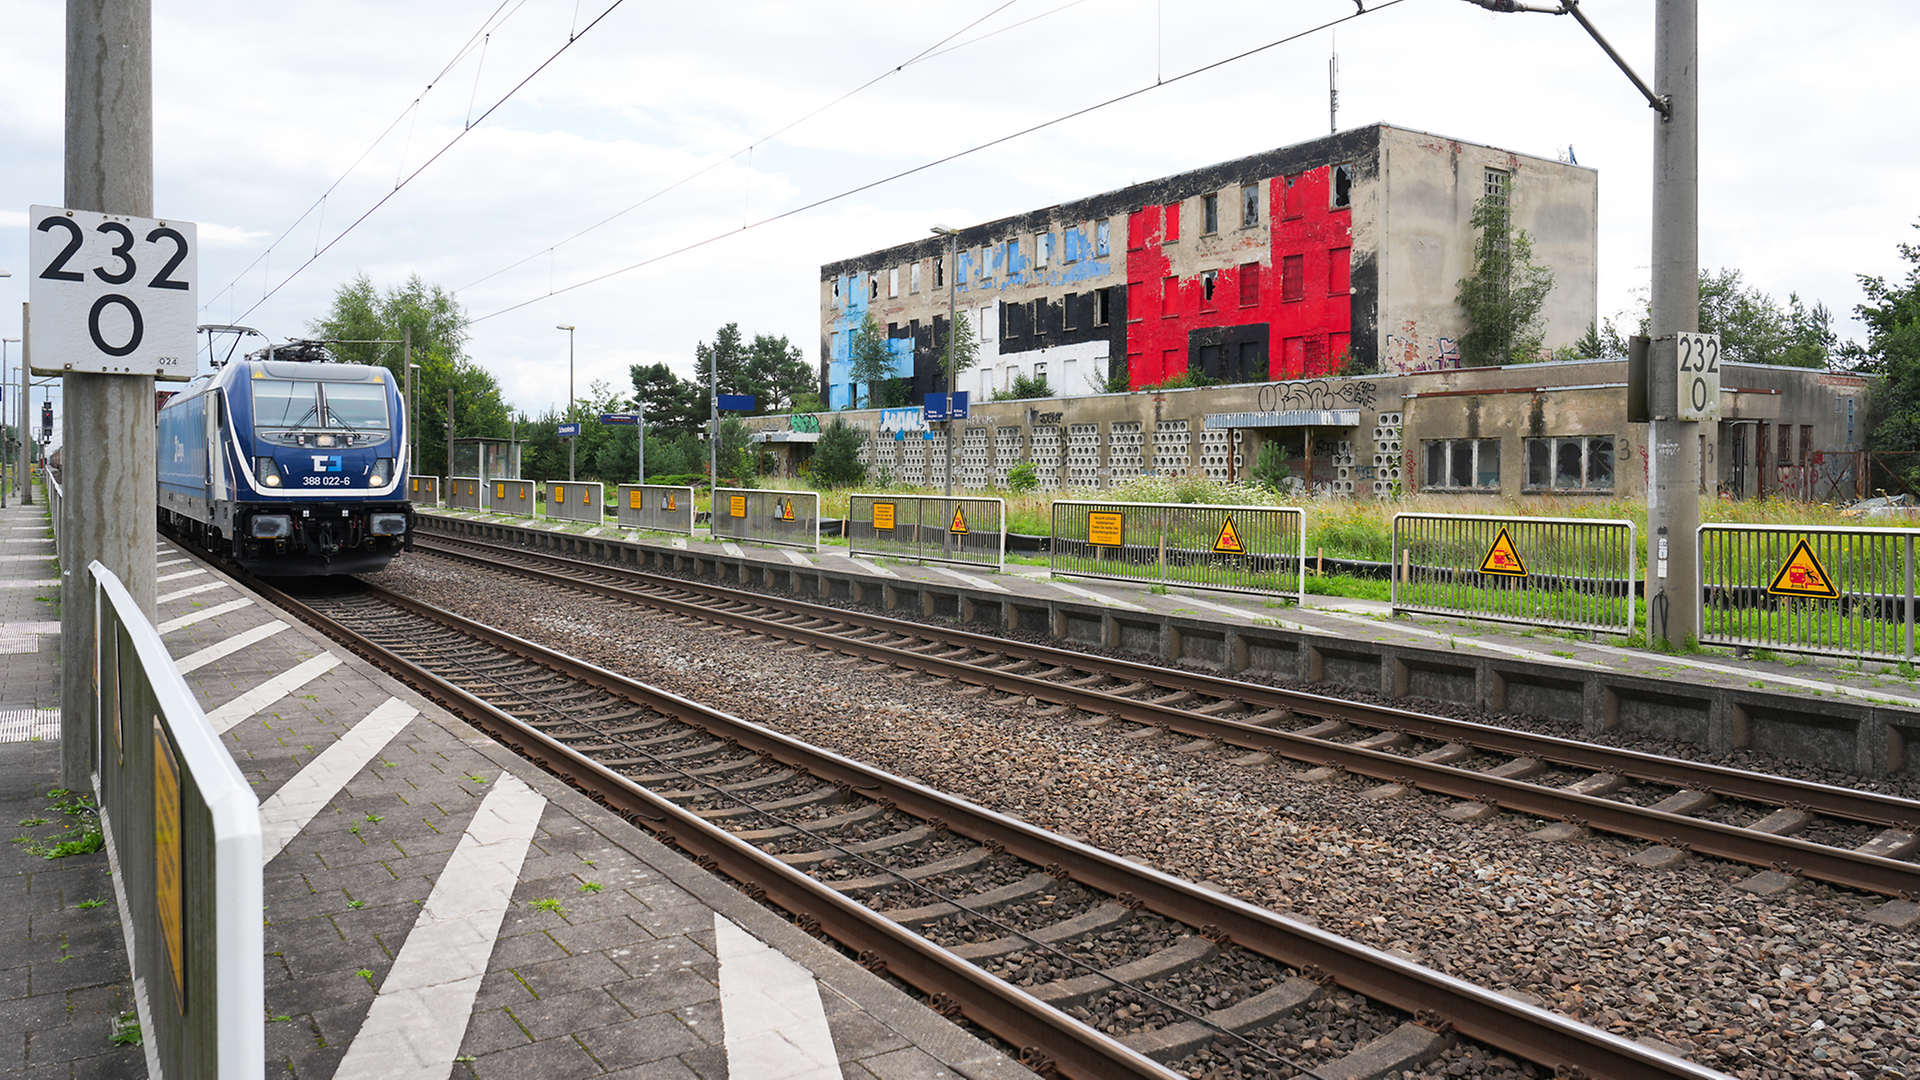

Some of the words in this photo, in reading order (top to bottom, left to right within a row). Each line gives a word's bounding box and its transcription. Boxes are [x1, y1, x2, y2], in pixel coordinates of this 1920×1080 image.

[36, 215, 190, 291] 232
[88, 293, 144, 357] 0
[158, 357, 177, 365] 024
[1679, 336, 1719, 374] 232
[1692, 376, 1707, 412] 0
[1619, 438, 1631, 461] 3
[302, 476, 321, 486] 388
[322, 476, 351, 486] 022-6
